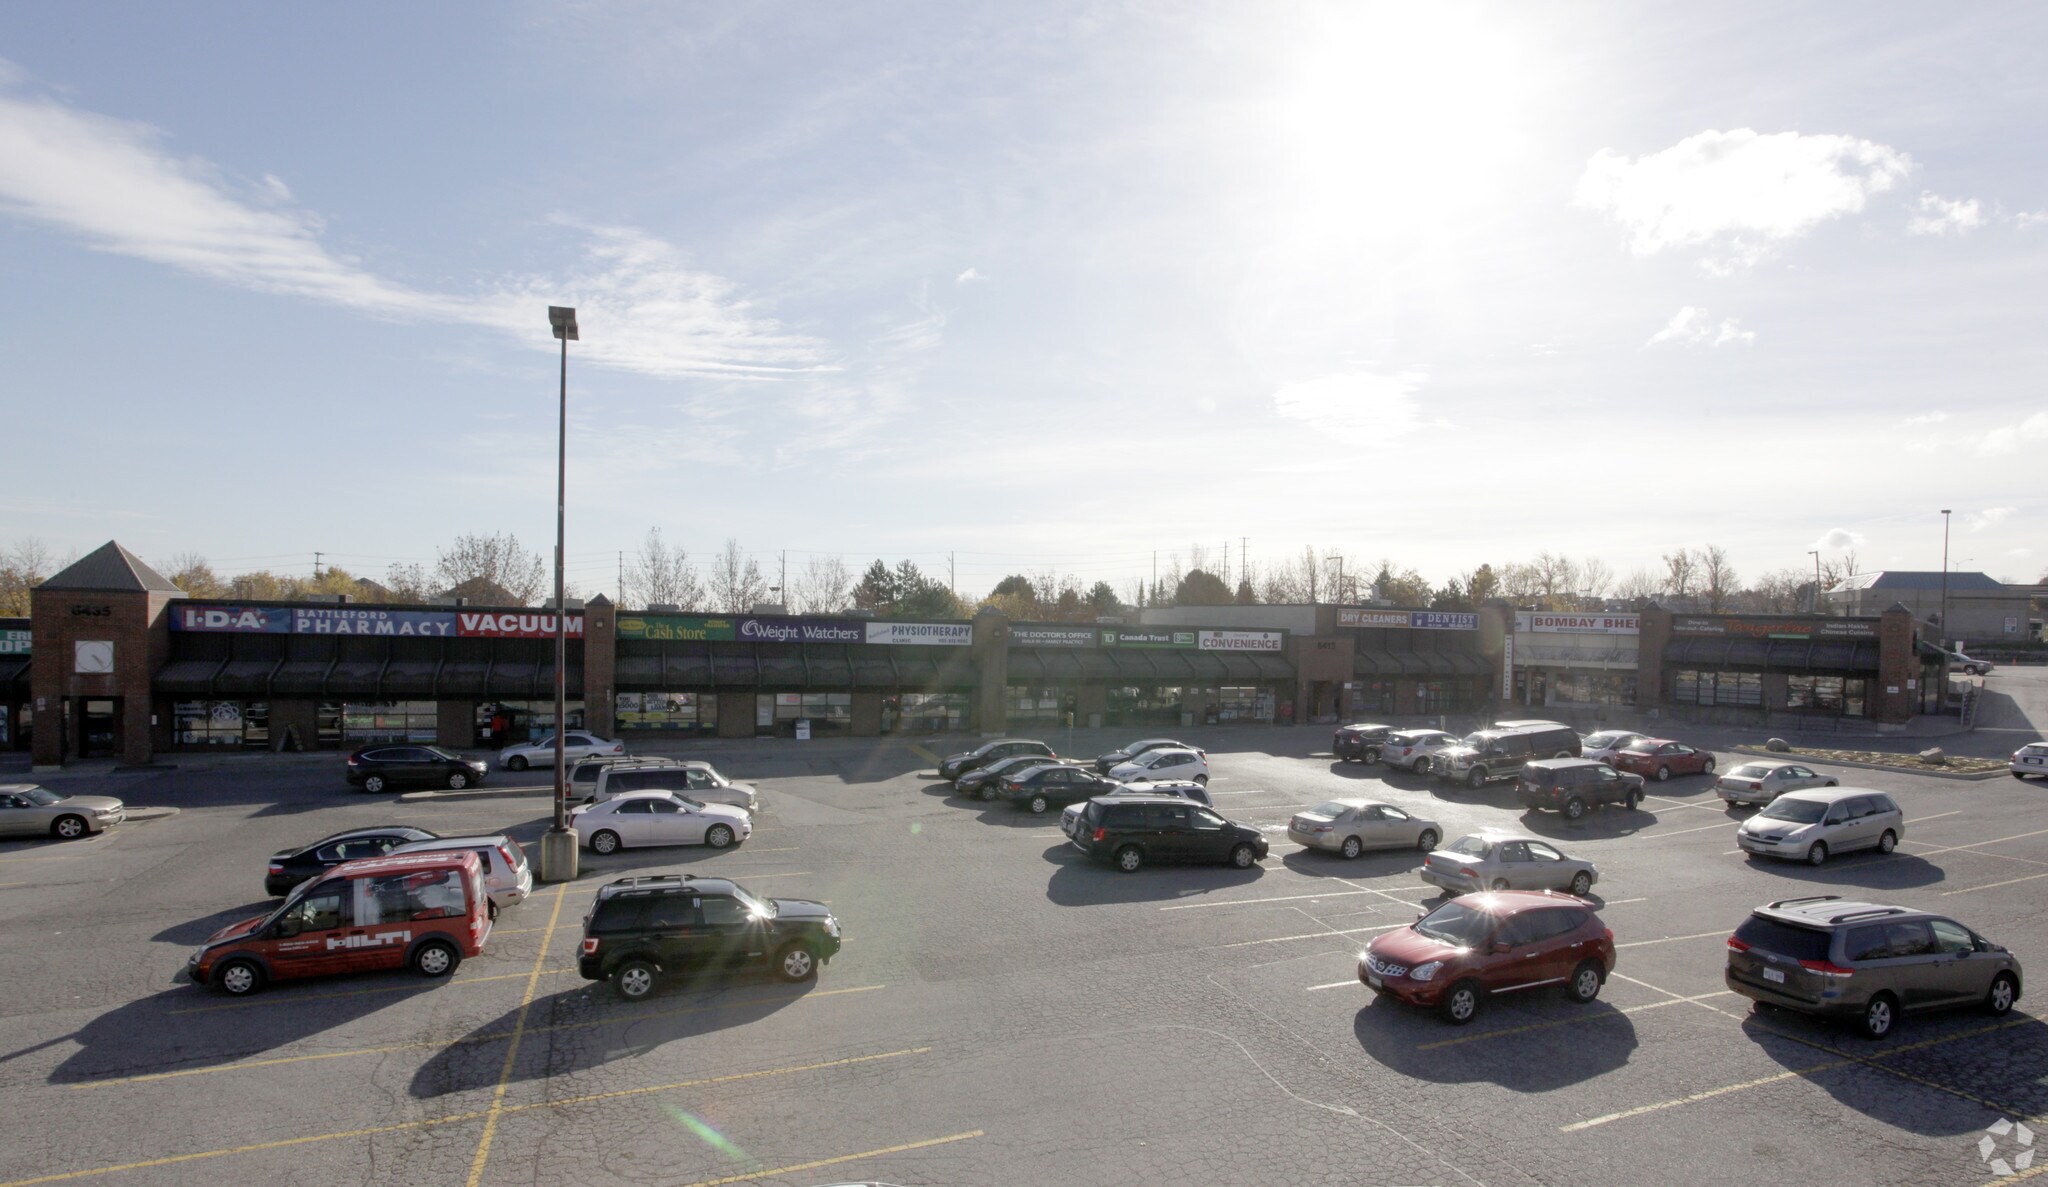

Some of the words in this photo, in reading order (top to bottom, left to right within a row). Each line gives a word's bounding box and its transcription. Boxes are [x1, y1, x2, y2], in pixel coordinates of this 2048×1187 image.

[297, 609, 387, 619] BATTLEFORD
[1340, 613, 1360, 622] DRY
[1362, 614, 1408, 624] CLEANERS
[1427, 613, 1475, 624] DENTIST
[297, 618, 450, 636] PHARMACY
[460, 613, 583, 633] VACUUM
[1534, 617, 1597, 628] BOMBAY
[645, 624, 674, 640] Cash
[676, 625, 707, 640] Store
[754, 625, 799, 641] Weight
[802, 625, 859, 640] Watchers
[891, 625, 971, 637] PHYSIOTHERAPY
[1103, 633, 1115, 643] TD
[1119, 633, 1148, 641] Canada
[1203, 638, 1279, 649] CONVENIENCE
[326, 930, 412, 950] HILTI
